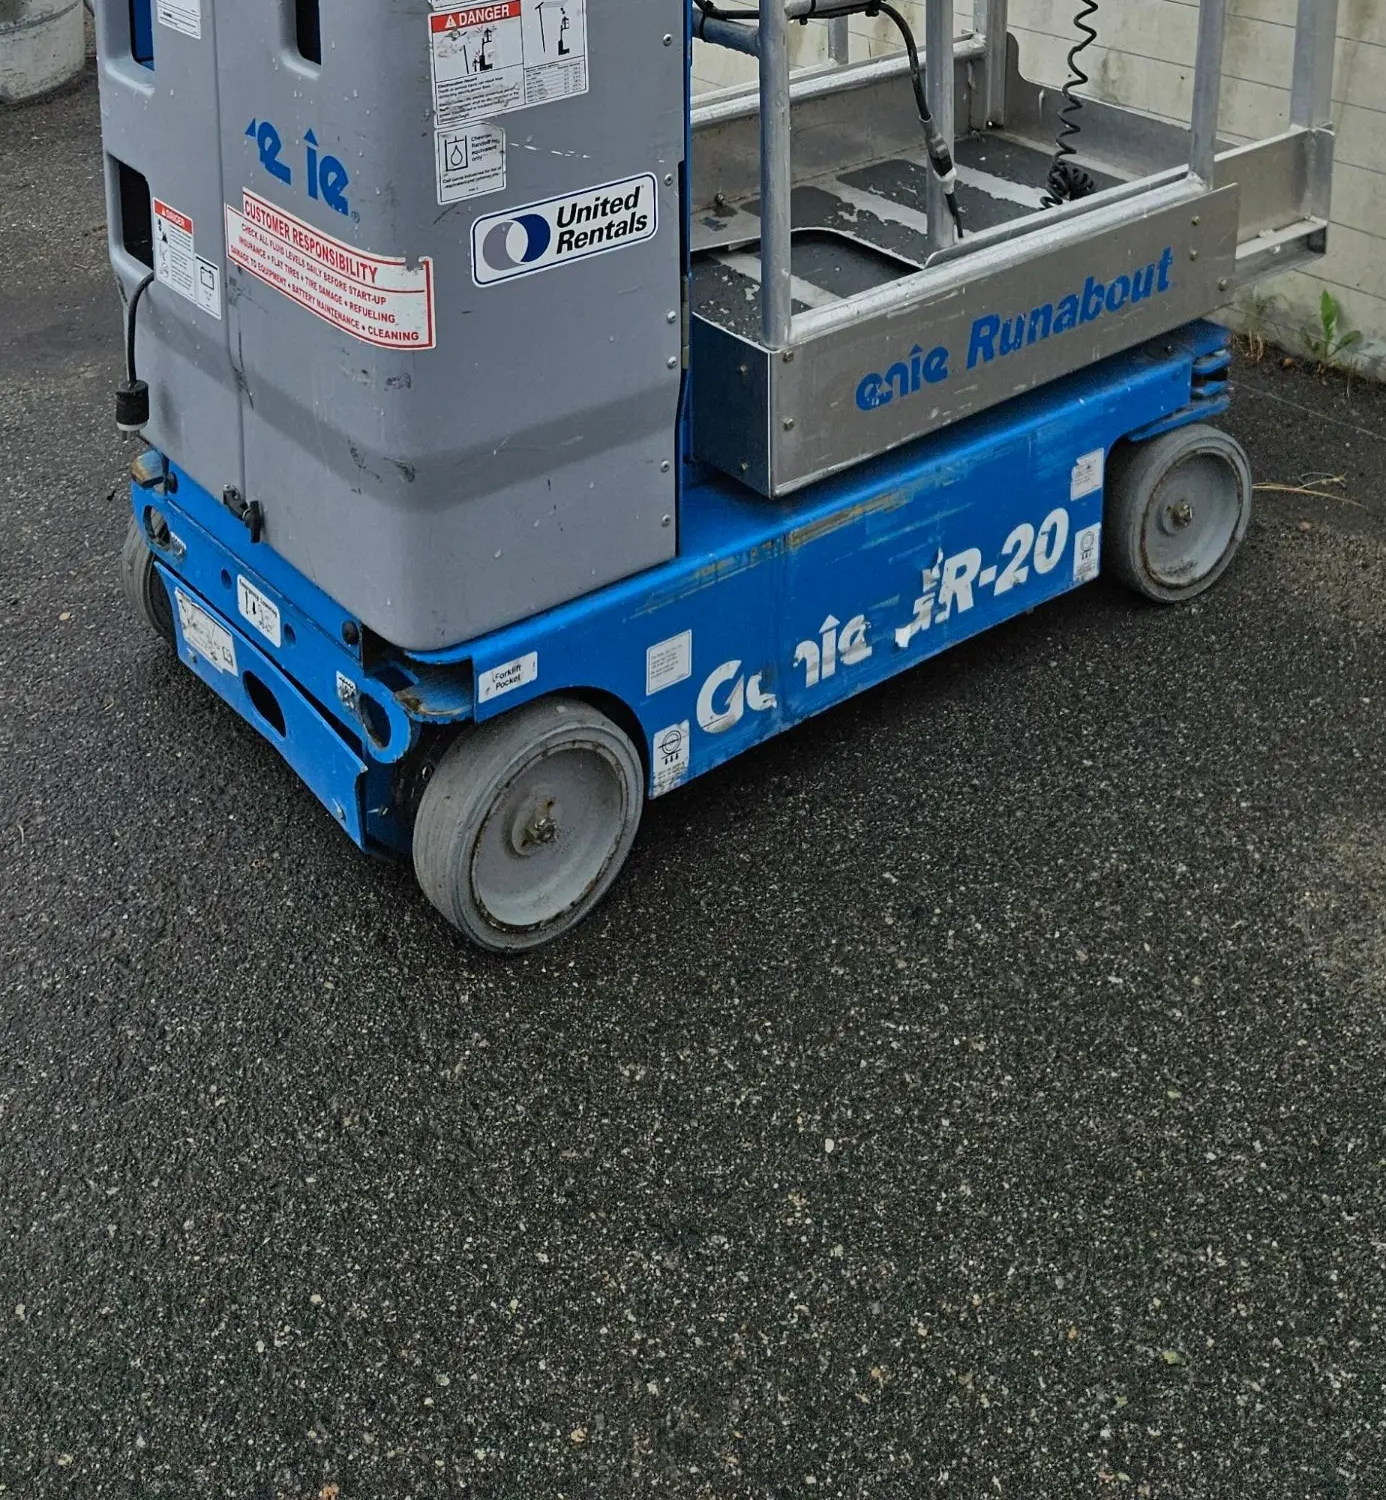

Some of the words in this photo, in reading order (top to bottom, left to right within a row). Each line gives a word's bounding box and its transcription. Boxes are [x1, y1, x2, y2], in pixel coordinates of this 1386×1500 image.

[459, 4, 510, 26] DANGER
[245, 200, 290, 241] CUSTOMER
[293, 228, 378, 283] RESPONSIBILITY
[556, 186, 641, 228] United
[556, 212, 648, 254] Rentals
[239, 236, 266, 260] INSURANCE
[271, 256, 283, 269] FLAT
[284, 265, 299, 280] TIRES
[304, 276, 318, 291] TIRE
[318, 284, 343, 305] DAMAGE
[349, 301, 396, 324] REFUELING
[242, 223, 258, 238] CHECK
[260, 234, 268, 245] ALL
[270, 240, 285, 255] FLUID
[285, 249, 305, 267] LEVELS
[306, 262, 321, 277] DAILY
[323, 272, 347, 292] BEFORE
[348, 285, 386, 305] START-UP
[250, 258, 257, 268] TO
[258, 262, 287, 287] EQUIPMENT
[291, 283, 315, 307] BATTERY
[316, 297, 360, 329] MAINTENANCE
[368, 326, 419, 341] CLEANING
[966, 247, 1174, 370] Runabout
[496, 674, 521, 690] Pocket
